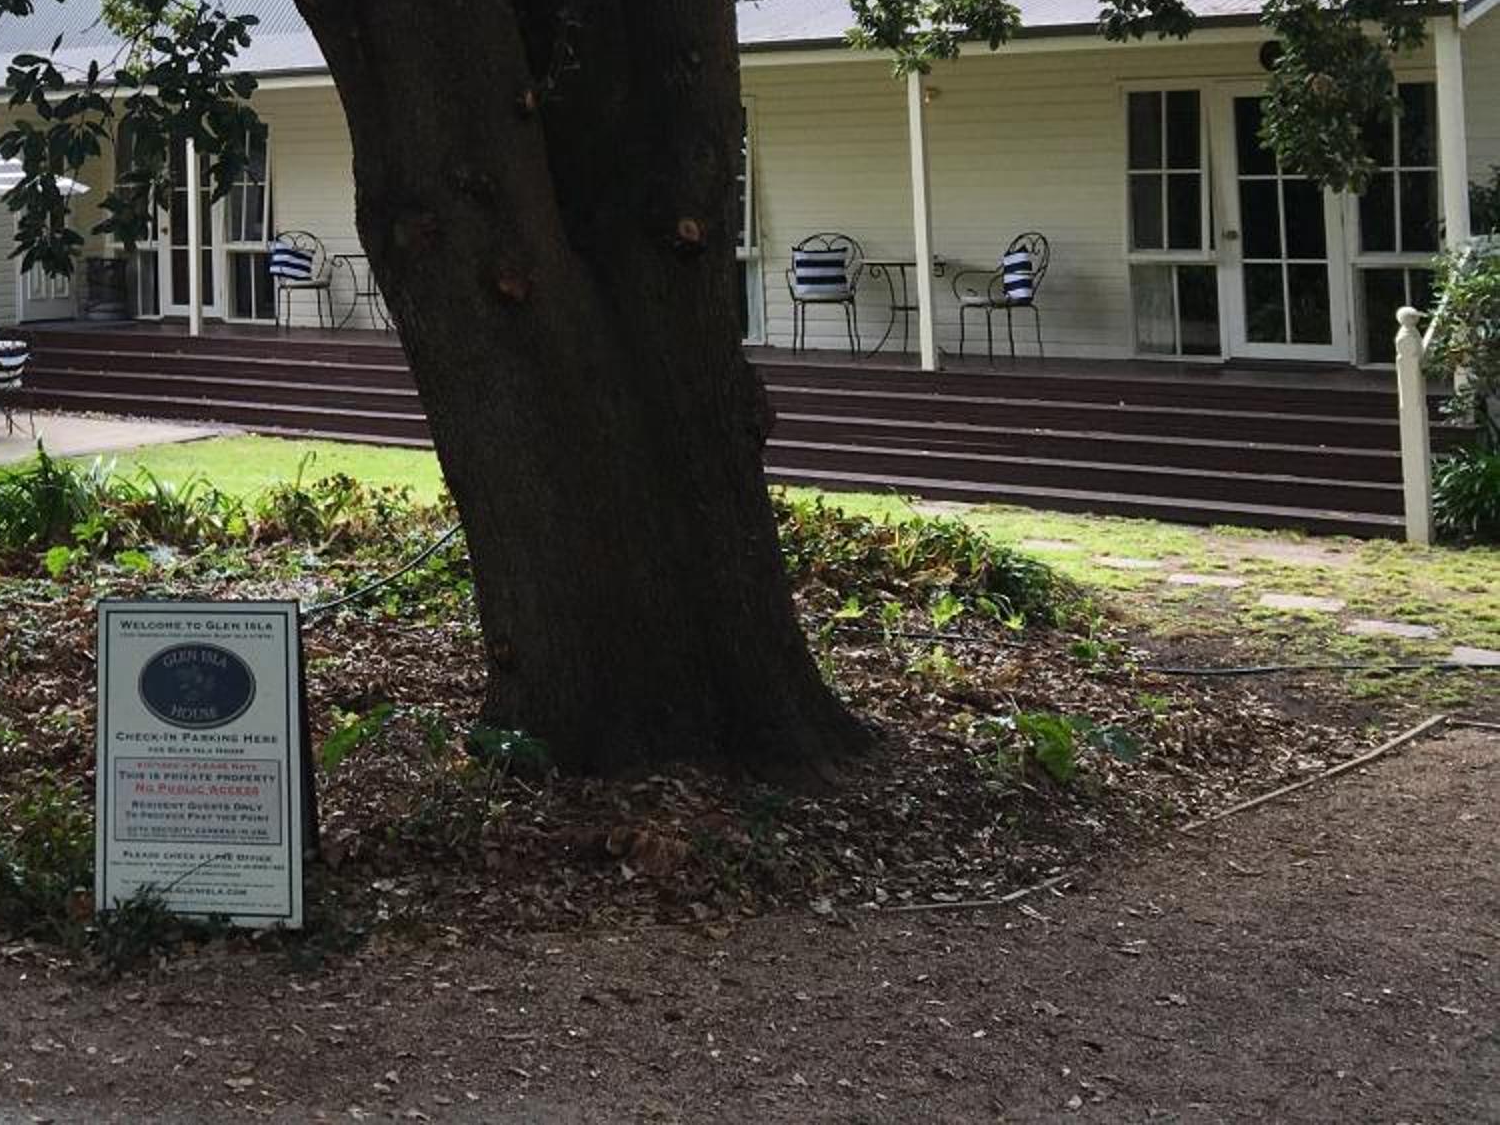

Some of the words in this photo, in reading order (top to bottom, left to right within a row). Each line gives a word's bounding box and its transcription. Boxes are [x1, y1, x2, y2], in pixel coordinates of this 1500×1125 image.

[120, 620, 180, 630] WELCOME
[186, 621, 200, 630] TO
[205, 620, 240, 631] GLEN
[245, 621, 273, 631] ISLA
[163, 651, 198, 668] GLEN
[201, 651, 228, 668] ISLA
[115, 732, 177, 742] CHECK-IN
[182, 733, 239, 743] PARKING
[243, 733, 278, 744] HERE
[119, 771, 145, 780] THIS
[163, 772, 212, 782] PRIVATE
[217, 772, 276, 783] PROPERTY
[135, 783, 153, 795] NO
[157, 783, 205, 796] PUBLIC
[208, 785, 260, 797] ACCESS
[131, 801, 185, 810] RESIDENT
[188, 801, 230, 812] GUESTS
[233, 801, 263, 812] ONLY
